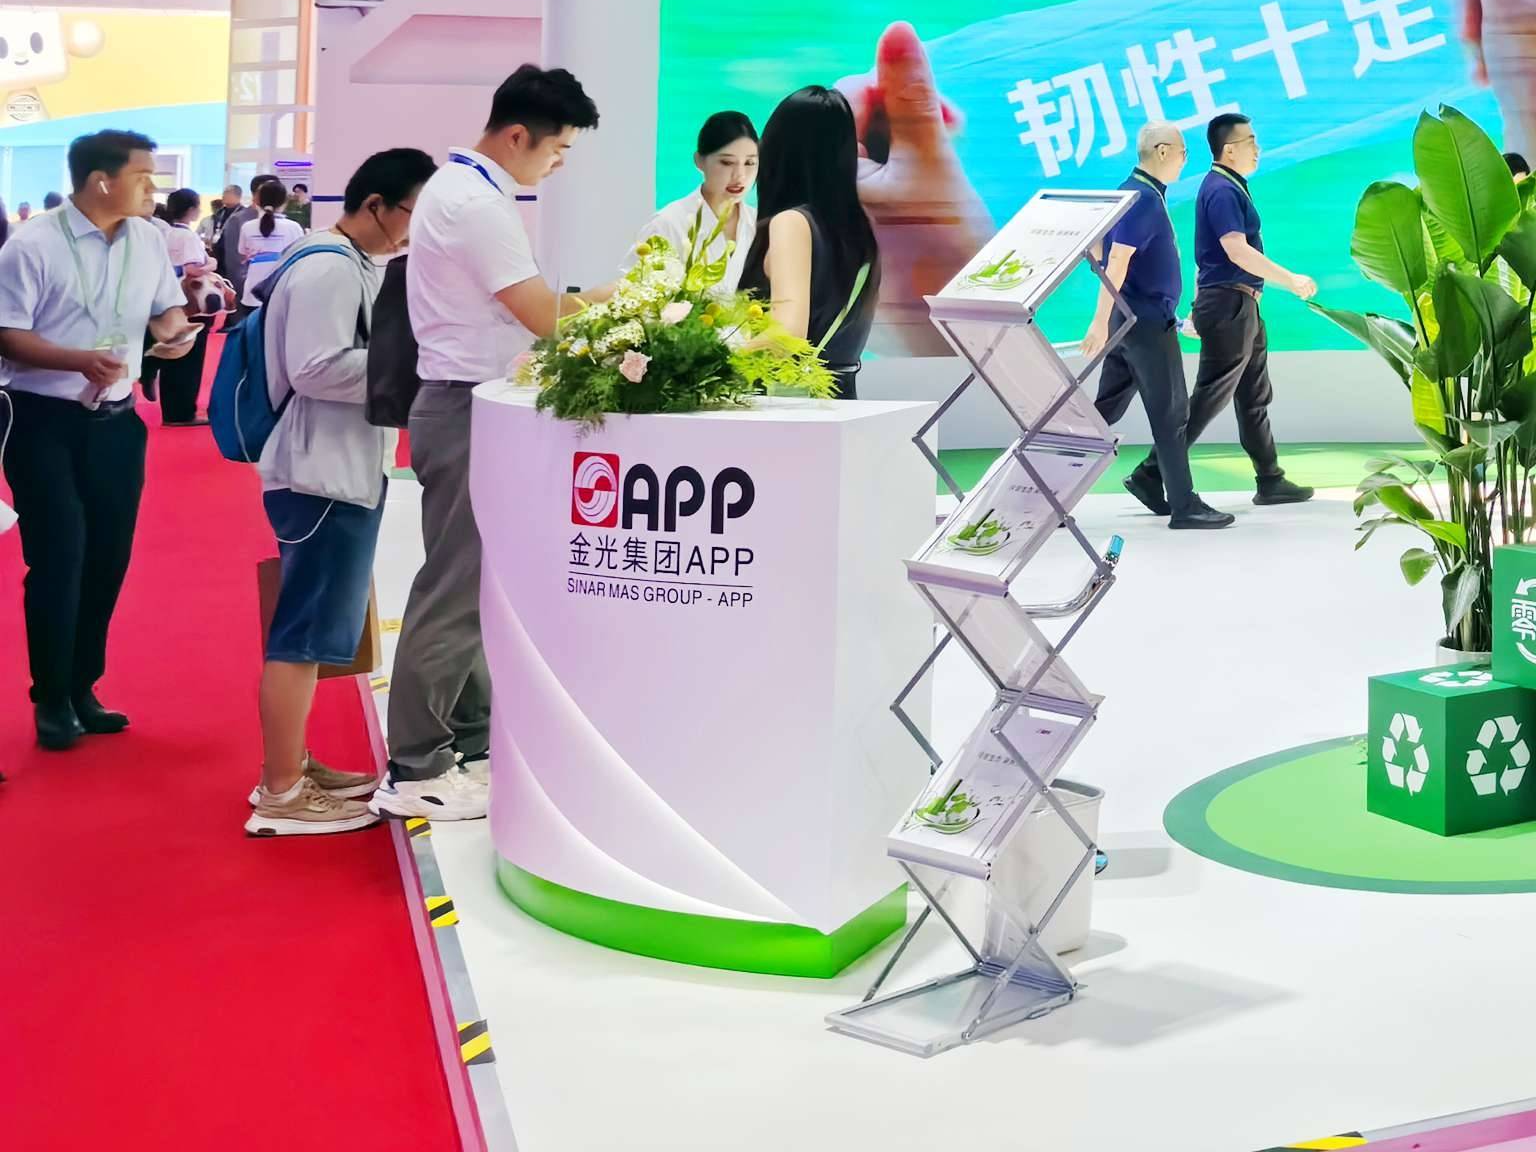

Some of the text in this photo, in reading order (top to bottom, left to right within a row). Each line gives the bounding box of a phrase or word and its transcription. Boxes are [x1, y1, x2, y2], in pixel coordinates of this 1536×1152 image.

[622, 463, 755, 535] APP
[569, 532, 754, 577] 金光集团APP
[567, 578, 606, 598] SINAR
[609, 584, 640, 602] MAS
[643, 586, 703, 605] GROUP
[717, 592, 754, 608] APP
